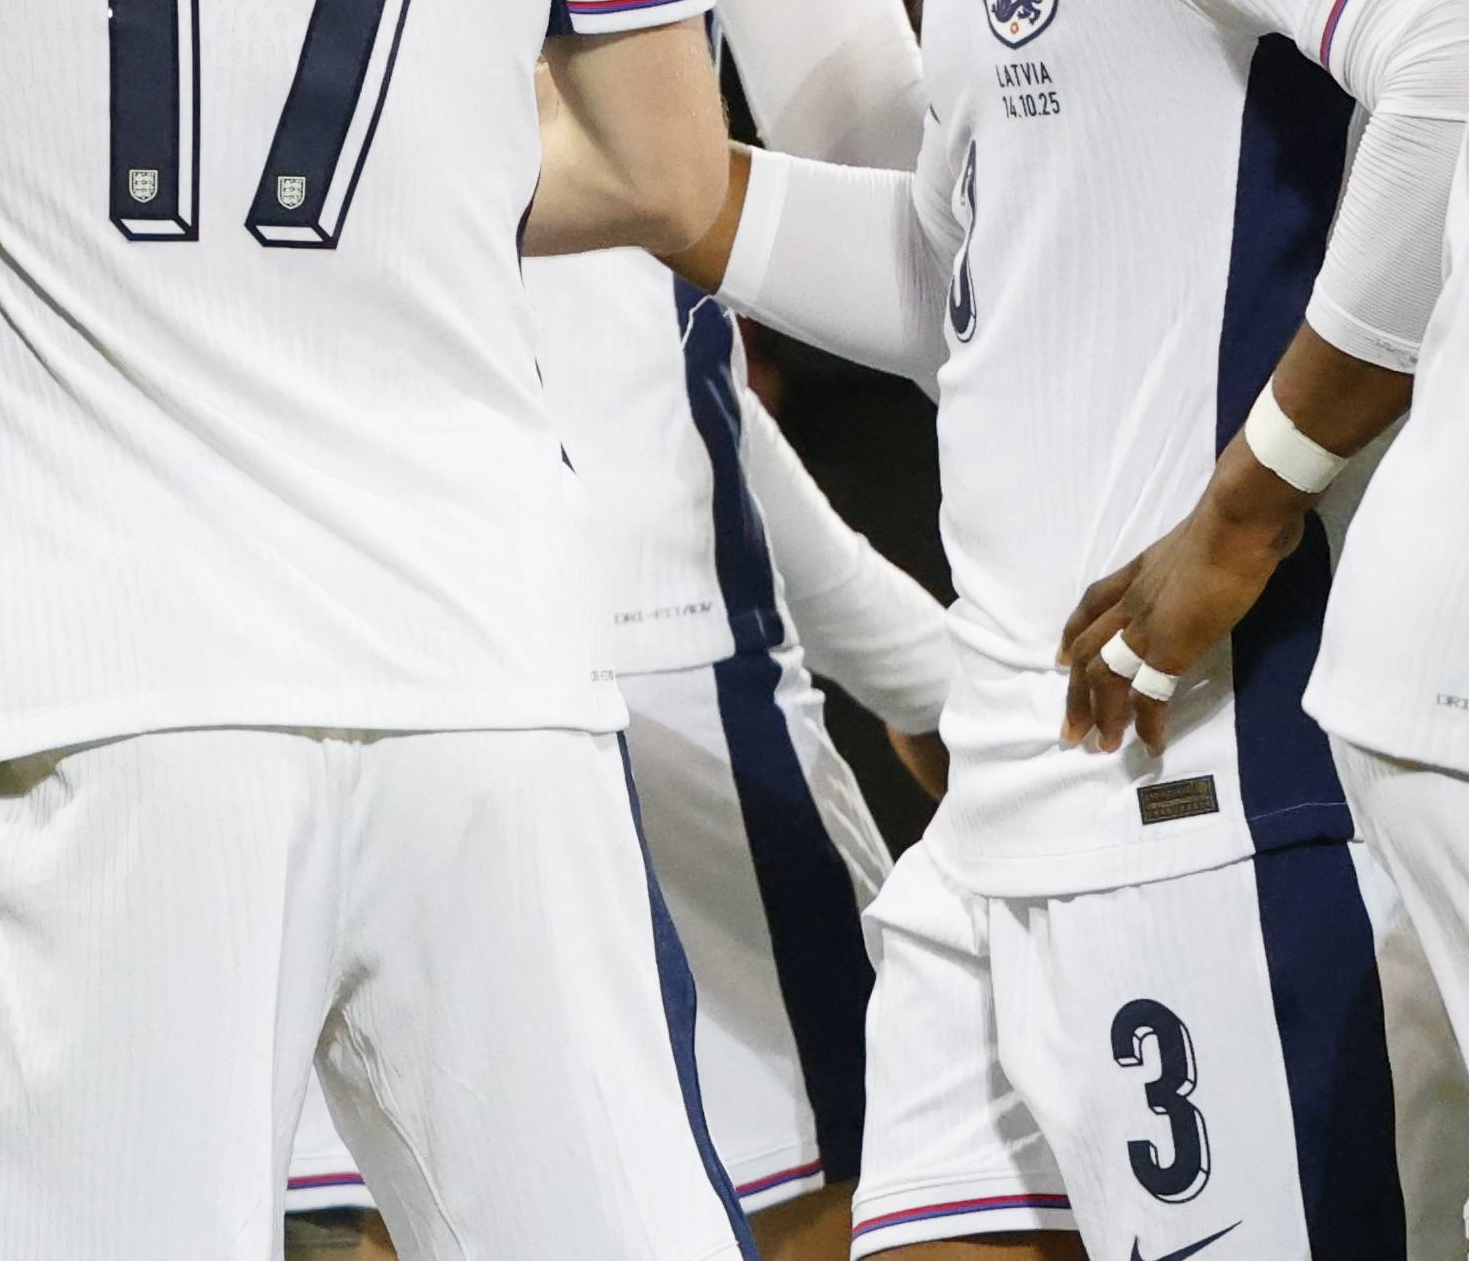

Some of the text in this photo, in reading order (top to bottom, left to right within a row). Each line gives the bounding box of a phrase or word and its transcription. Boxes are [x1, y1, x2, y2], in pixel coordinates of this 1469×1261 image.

[995, 61, 1053, 88] LATVIA
[1002, 91, 1061, 119] 14.10.25
[1110, 998, 1211, 1204] 3
